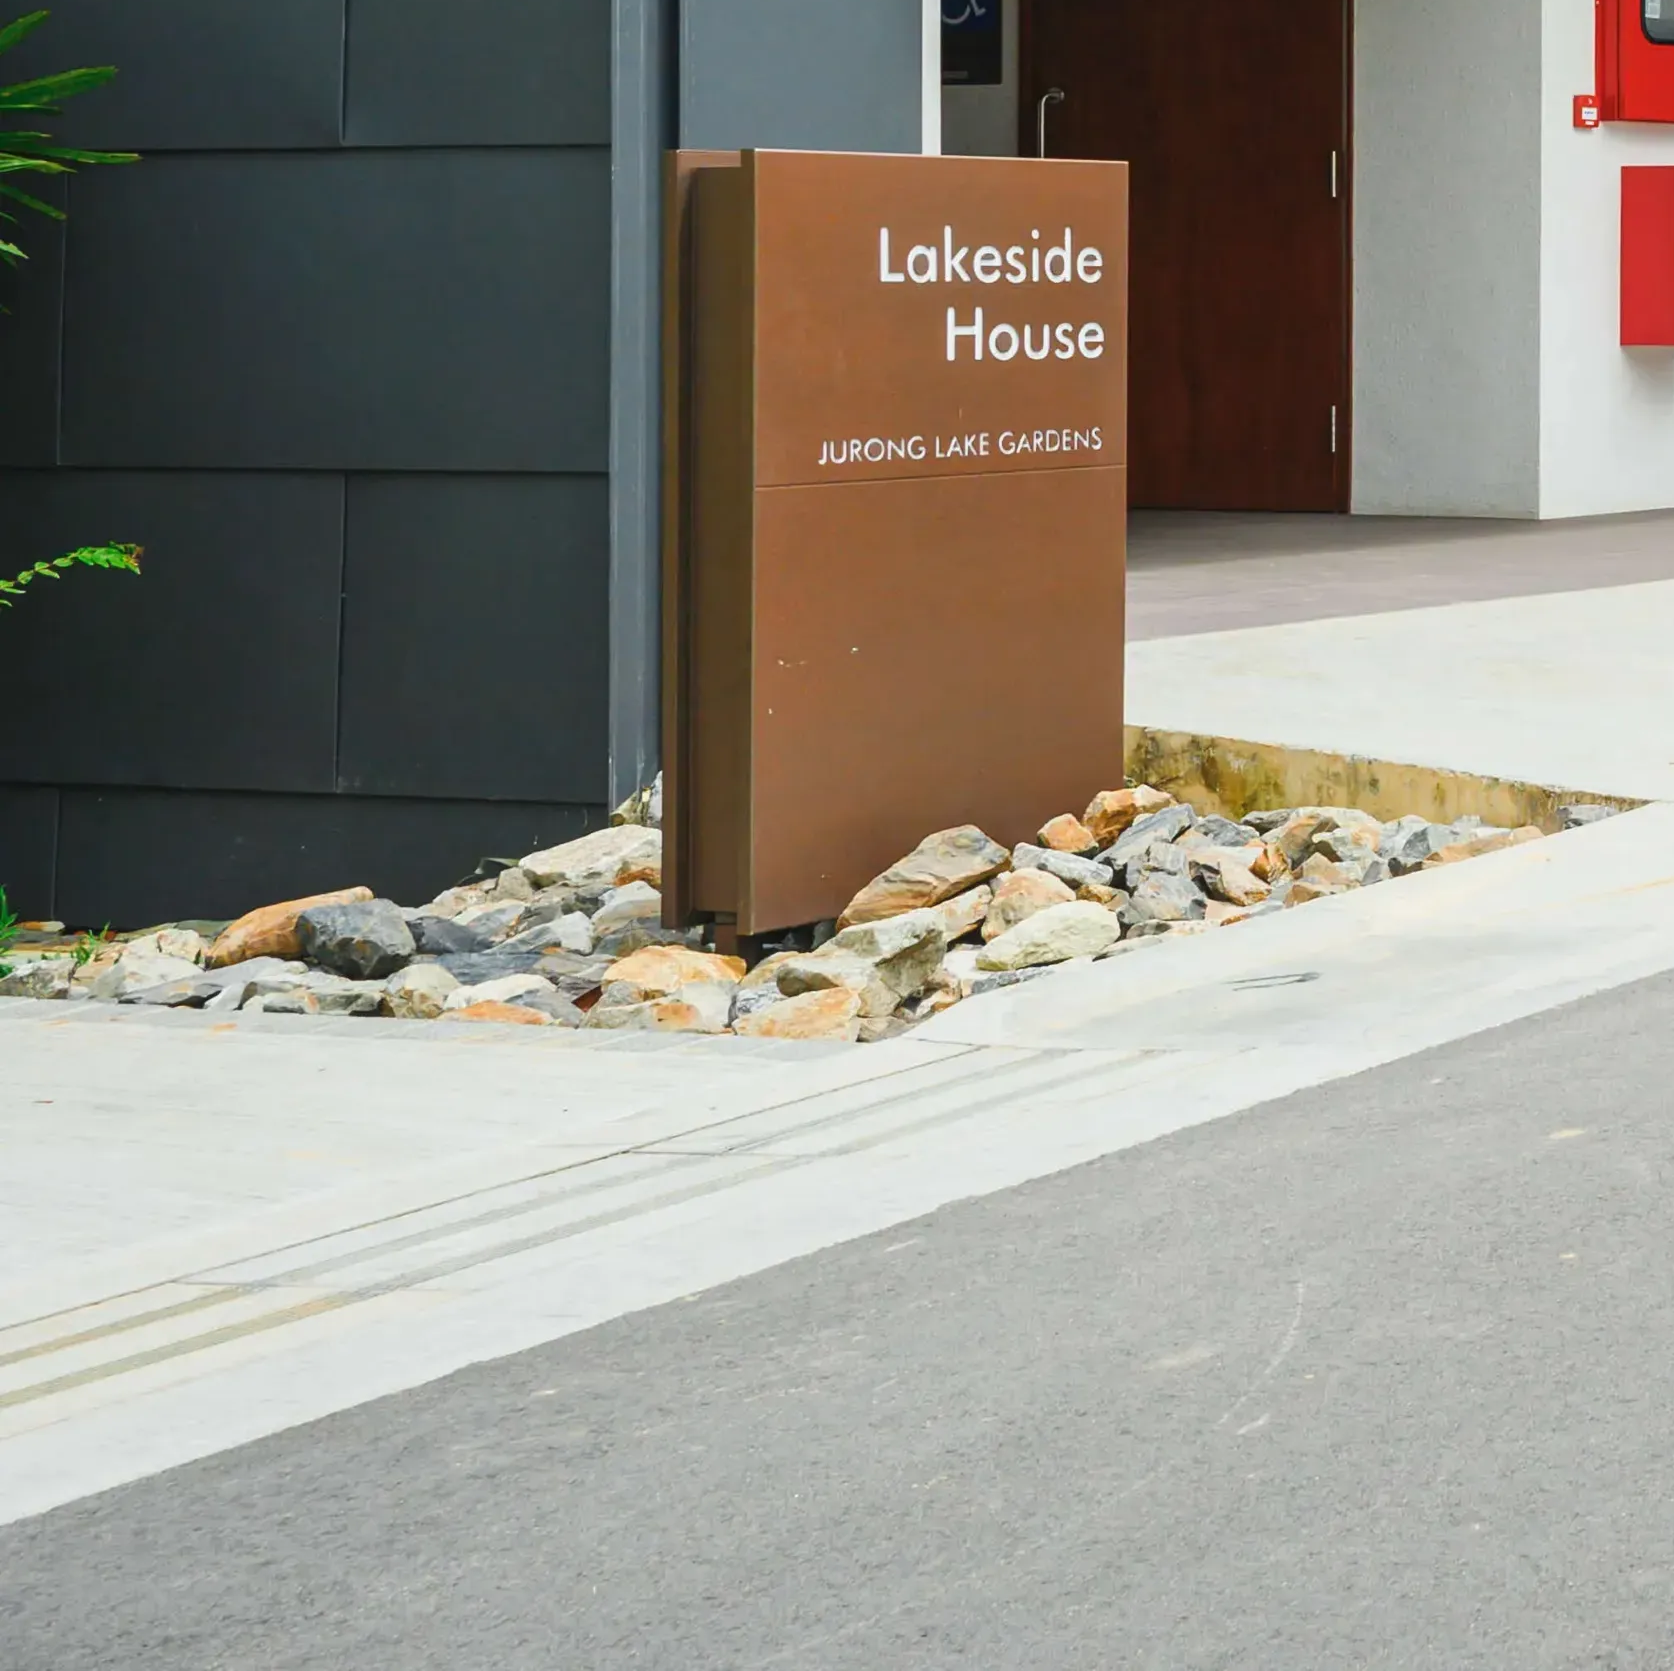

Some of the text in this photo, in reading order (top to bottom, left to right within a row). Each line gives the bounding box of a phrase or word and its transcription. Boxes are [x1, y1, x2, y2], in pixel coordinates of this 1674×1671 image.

[879, 225, 1103, 284] Lakeside
[946, 306, 1105, 362] House
[818, 426, 1103, 465] JURONG LAKE GARDENS
